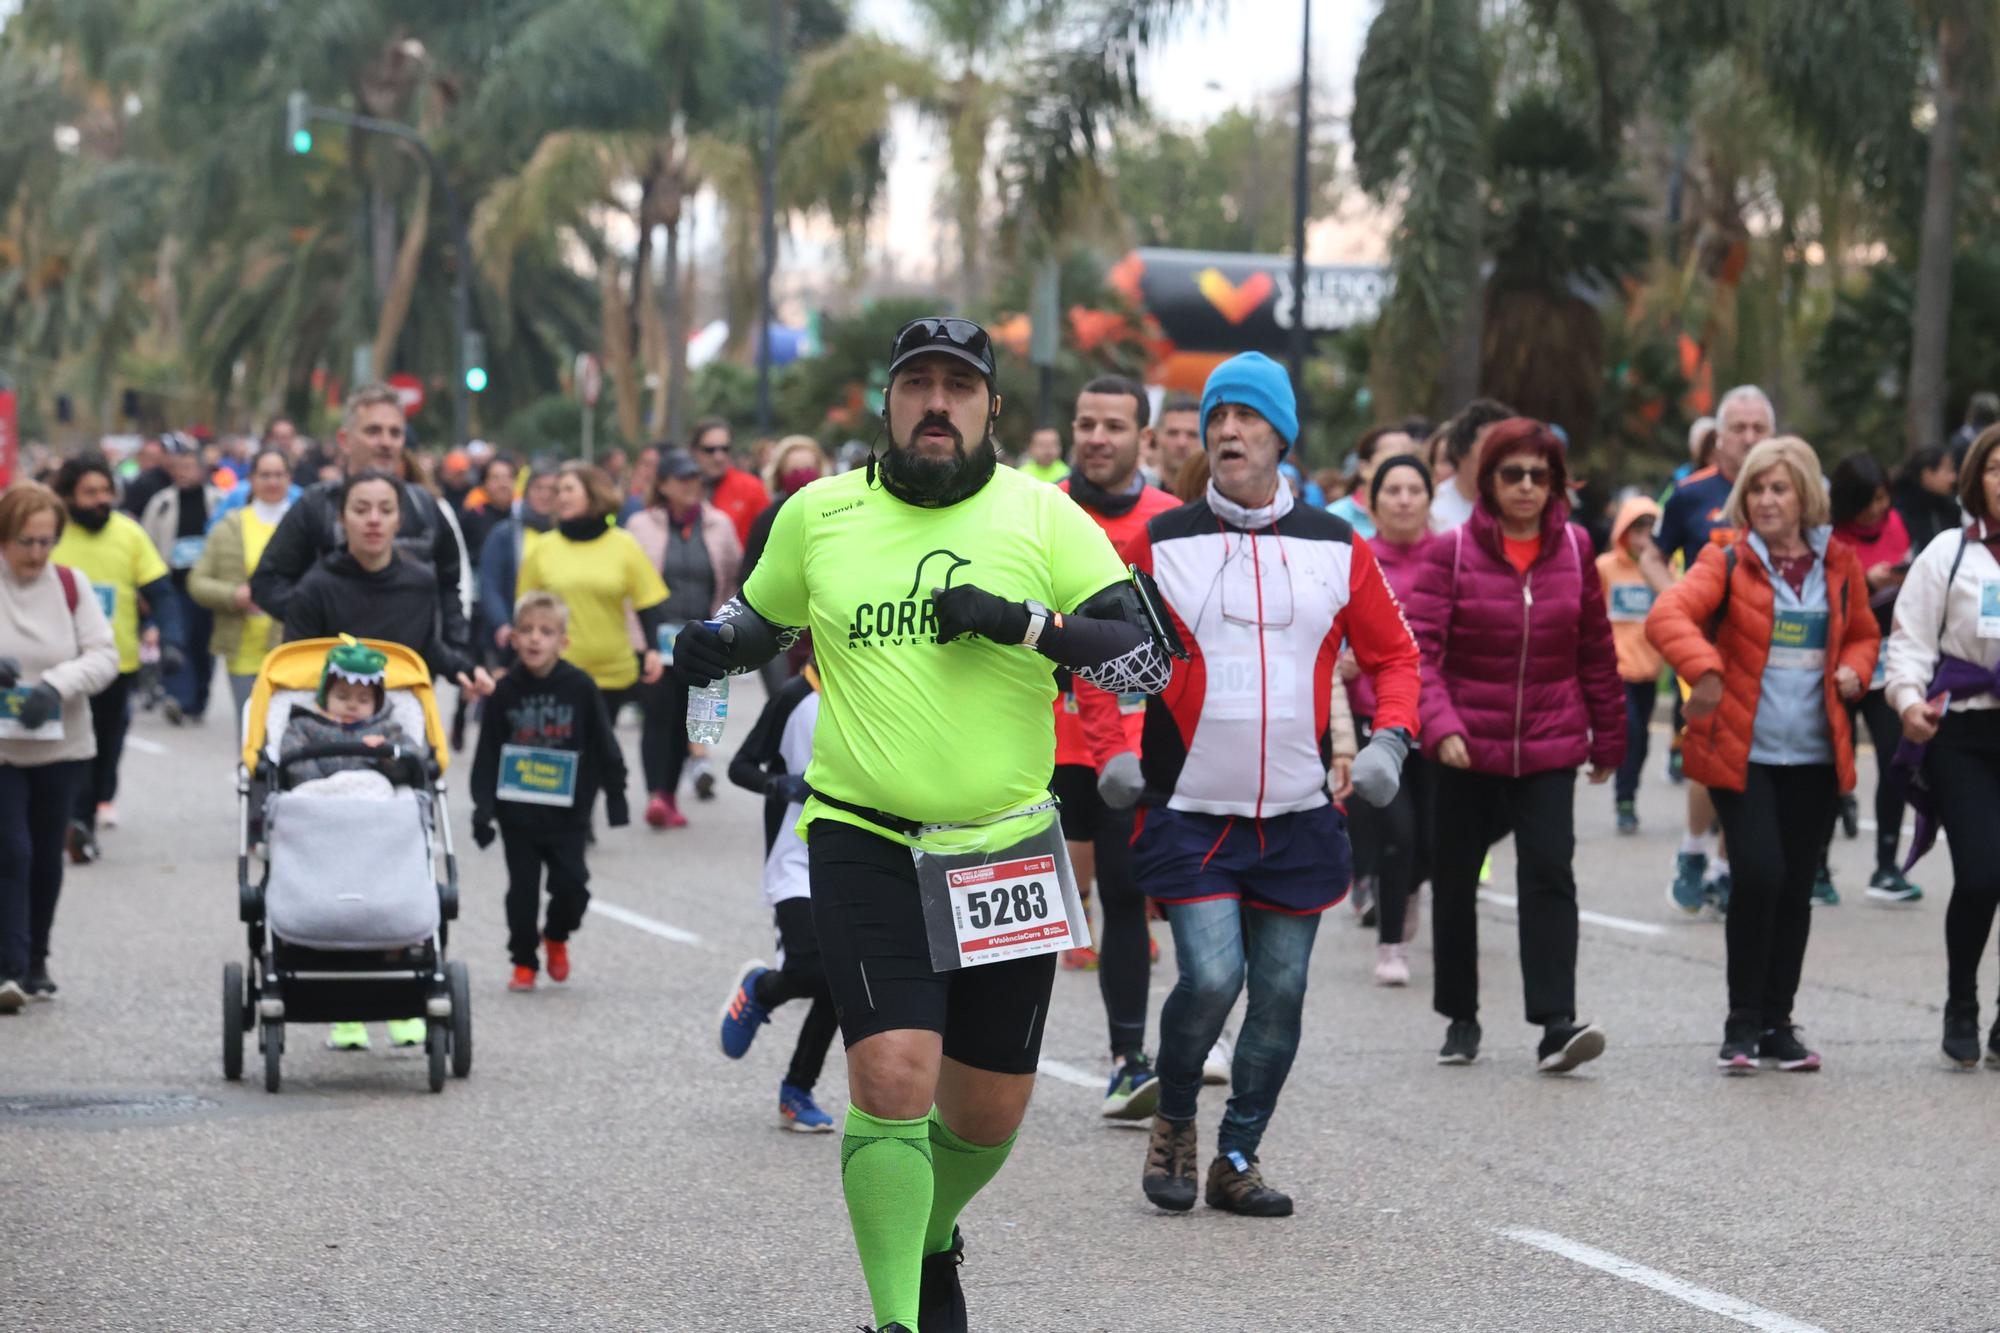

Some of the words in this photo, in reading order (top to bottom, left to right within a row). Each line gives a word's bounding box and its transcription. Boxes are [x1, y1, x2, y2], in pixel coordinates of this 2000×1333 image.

[821, 503, 853, 518] luanvi
[856, 599, 942, 638] CORR
[967, 881, 1048, 929] 5283
[988, 931, 1041, 945] #ValènciaCorre
